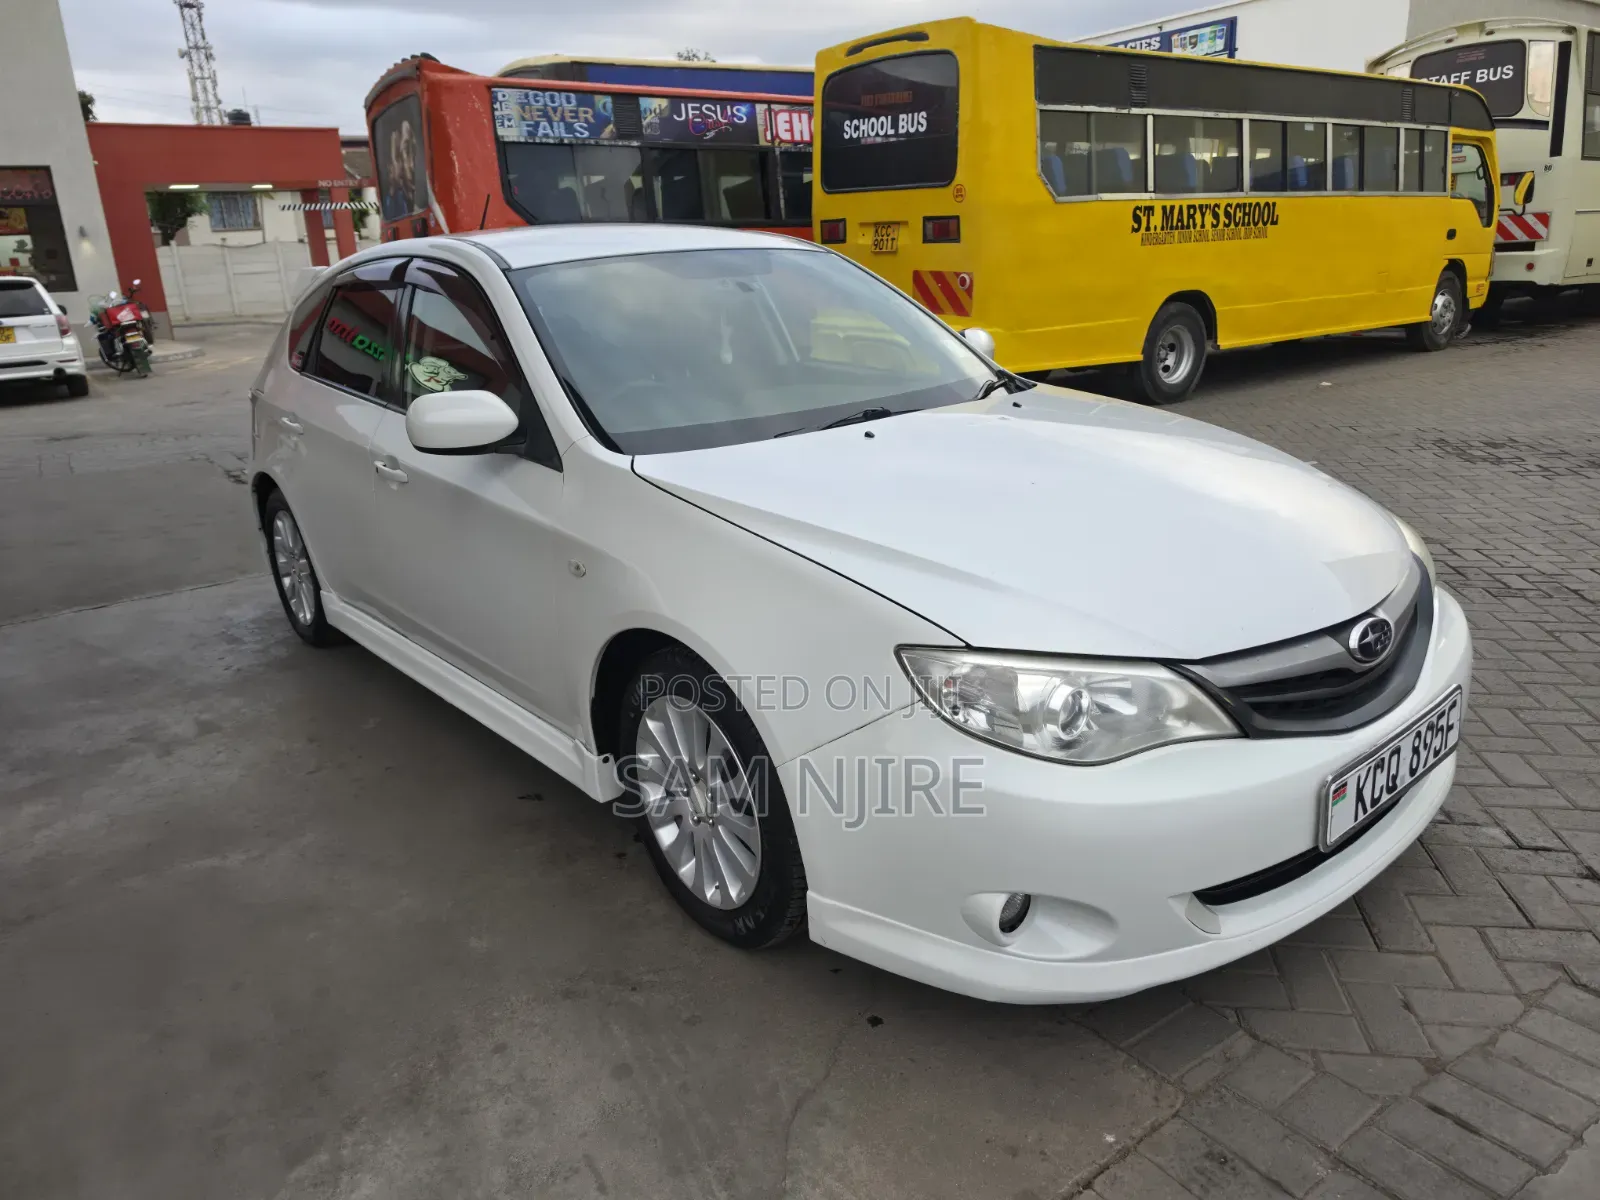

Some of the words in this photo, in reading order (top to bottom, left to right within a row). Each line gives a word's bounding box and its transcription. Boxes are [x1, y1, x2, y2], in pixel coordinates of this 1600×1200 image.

[1420, 71, 1471, 85] TAFF
[1475, 64, 1514, 83] BUS
[528, 90, 577, 107] GOD
[514, 106, 595, 123] NEVER
[673, 102, 747, 123] JESUS
[520, 121, 590, 138] FAILS
[764, 109, 814, 142] JEH
[843, 115, 895, 140] SCHOOL
[898, 111, 927, 134] BUS
[1131, 205, 1157, 233] ST.
[1160, 202, 1221, 232] MARY'S
[1223, 201, 1279, 228] SCHOOL
[874, 225, 892, 238] KCC
[873, 238, 896, 251] 901T
[1354, 744, 1401, 823] KCQ
[1408, 698, 1457, 778] 895F
